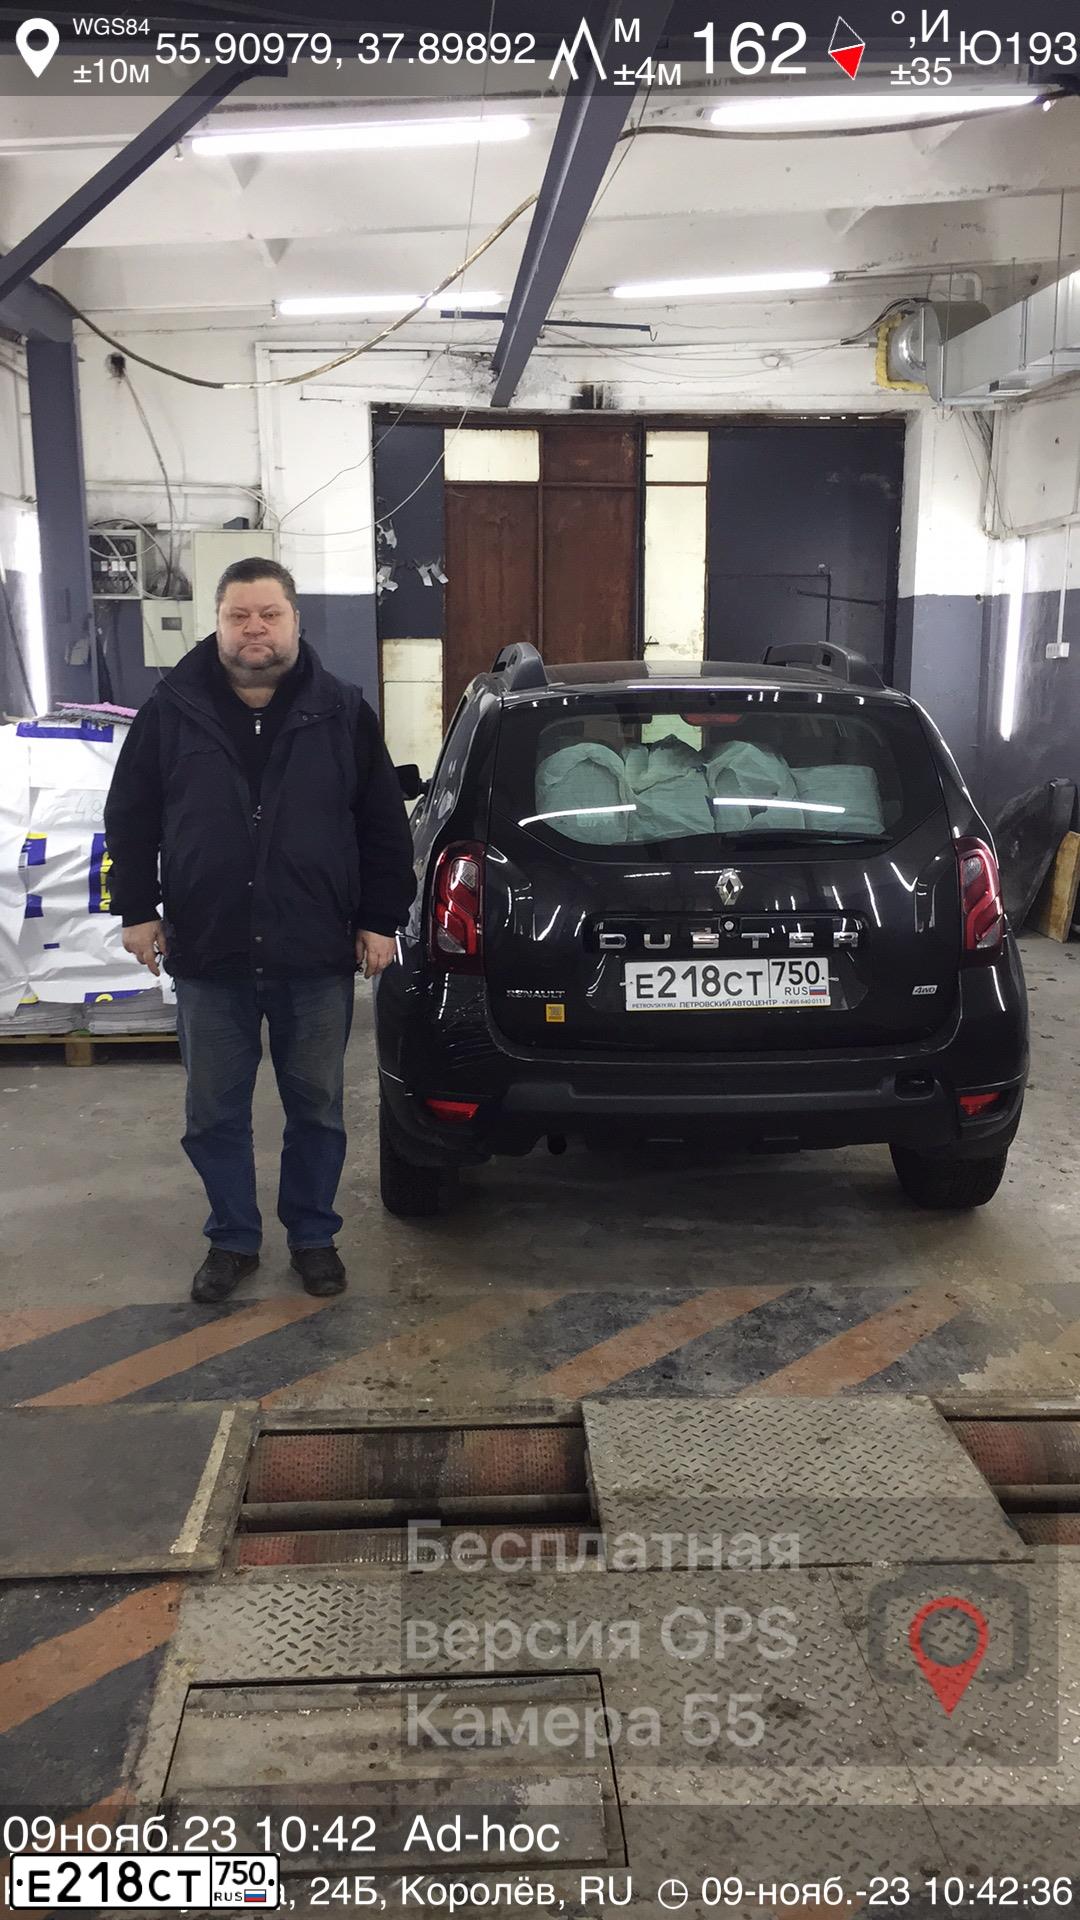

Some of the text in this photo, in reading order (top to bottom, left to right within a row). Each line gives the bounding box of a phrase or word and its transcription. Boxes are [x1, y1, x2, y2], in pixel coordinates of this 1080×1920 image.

[599, 932, 859, 950] DUSTER
[770, 960, 821, 986] 750
[506, 989, 566, 999] RENAULT
[784, 986, 809, 996] RUS
[679, 999, 779, 1009] ПЕТРОВСКИЙ АВТОЦЕНТР
